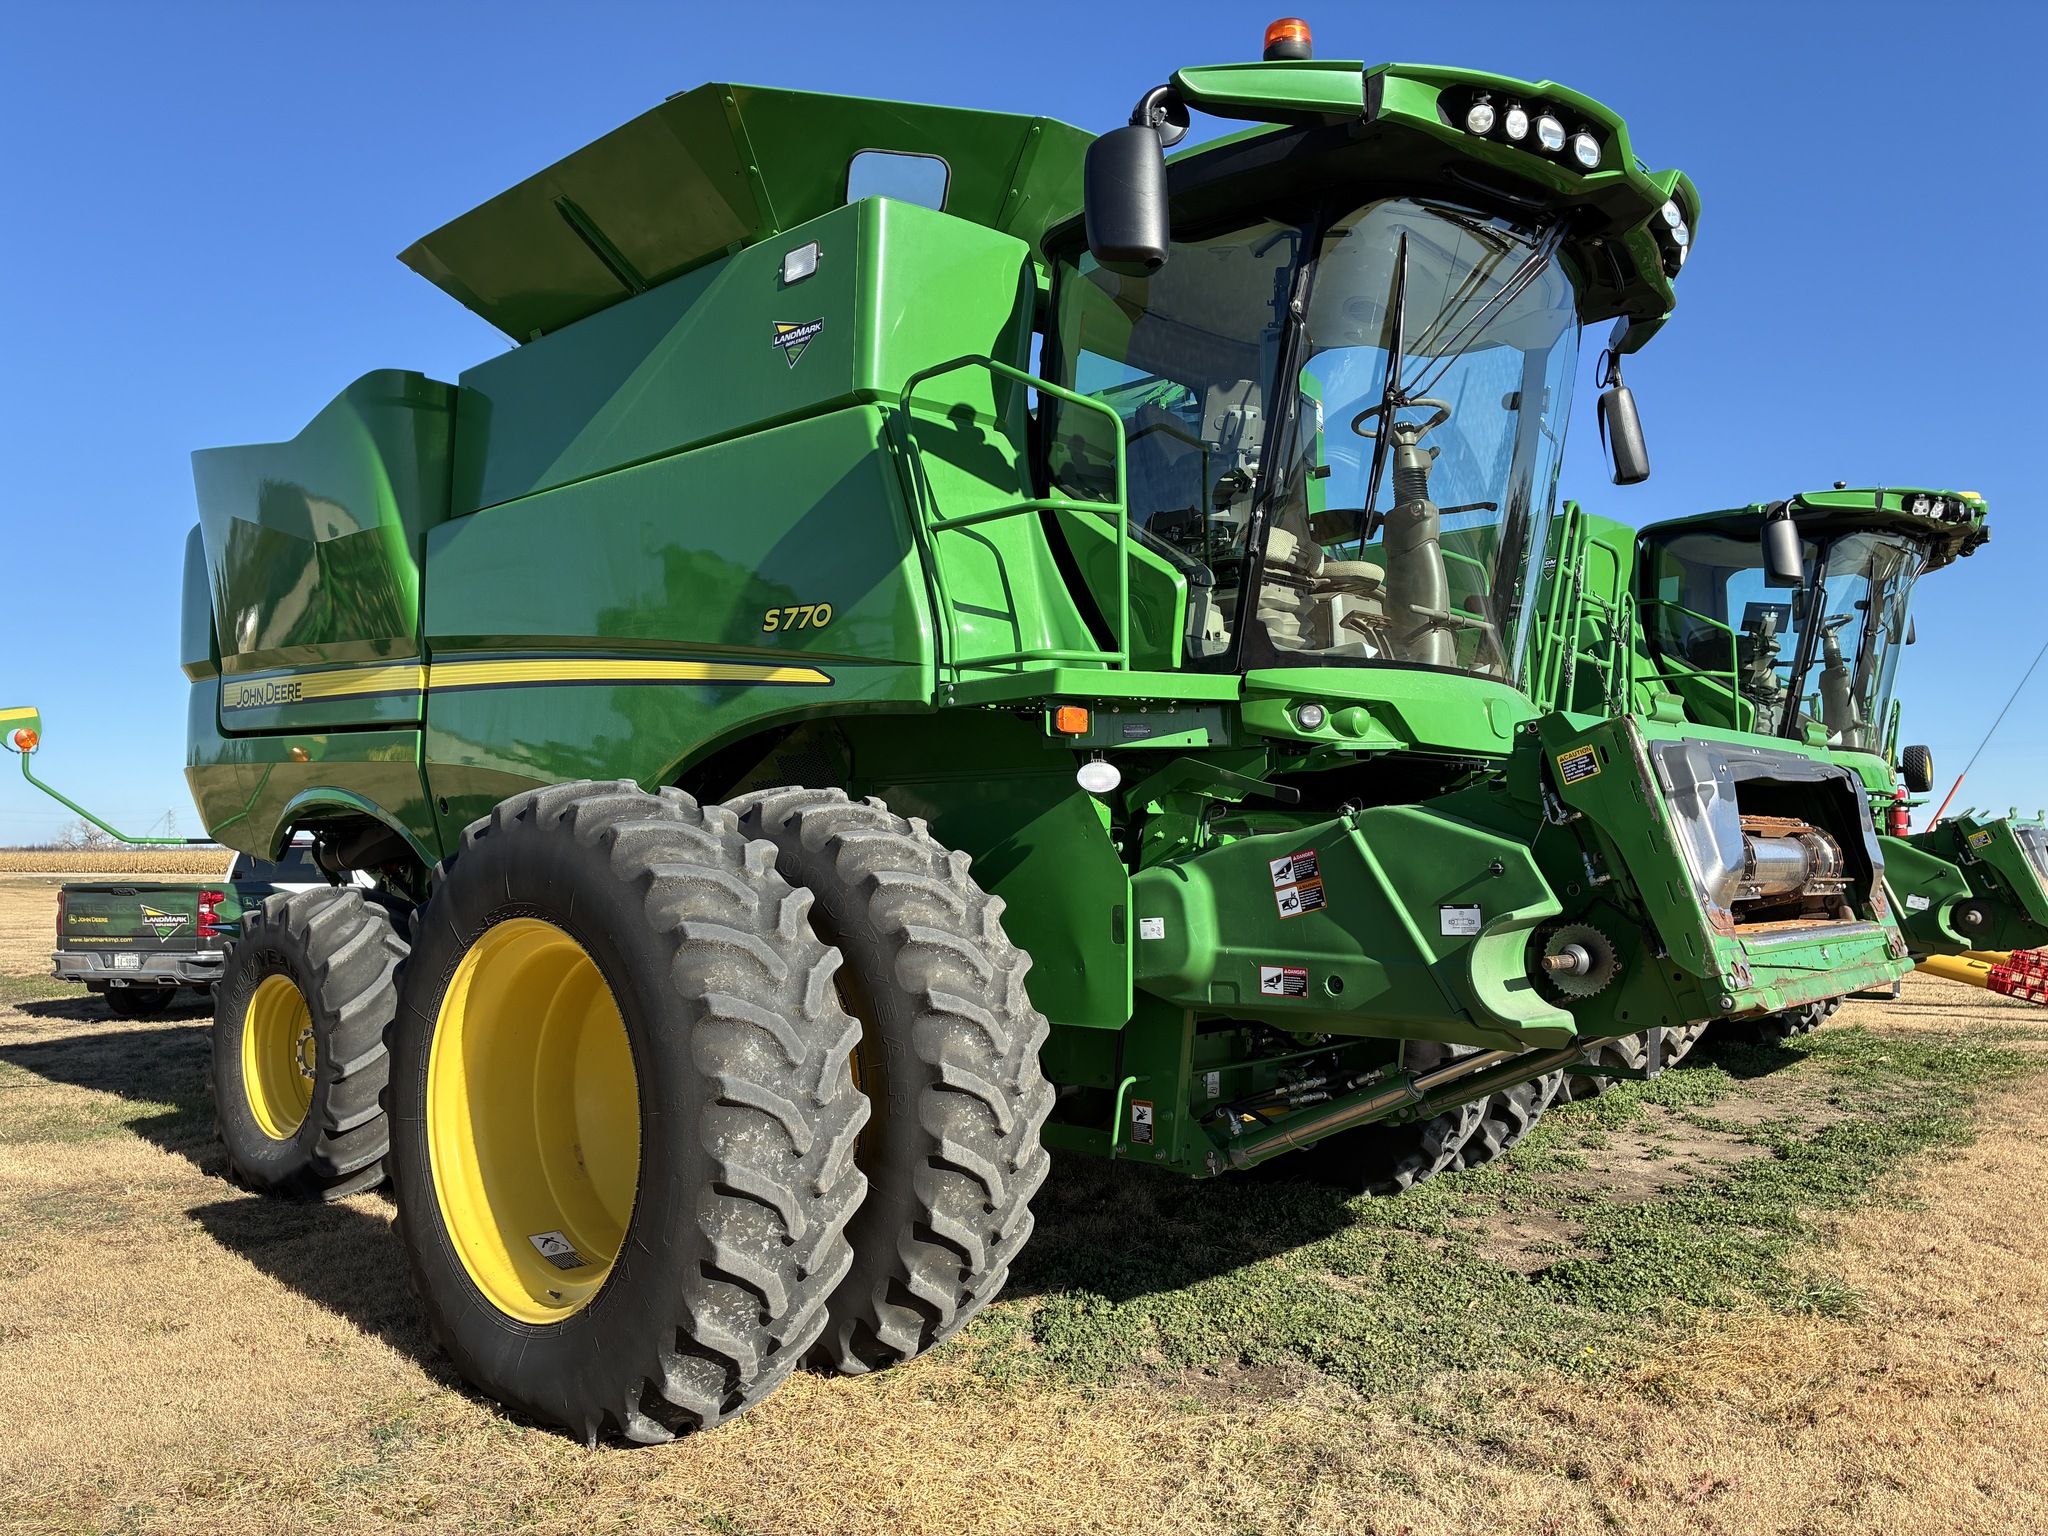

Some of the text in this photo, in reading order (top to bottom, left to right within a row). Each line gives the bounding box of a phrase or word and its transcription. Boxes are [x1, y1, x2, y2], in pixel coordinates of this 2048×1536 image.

[774, 322, 822, 345] LANDMARK
[763, 602, 833, 632] S770
[236, 682, 303, 706] JOHN DEERE
[1563, 746, 1592, 760] CAUTION
